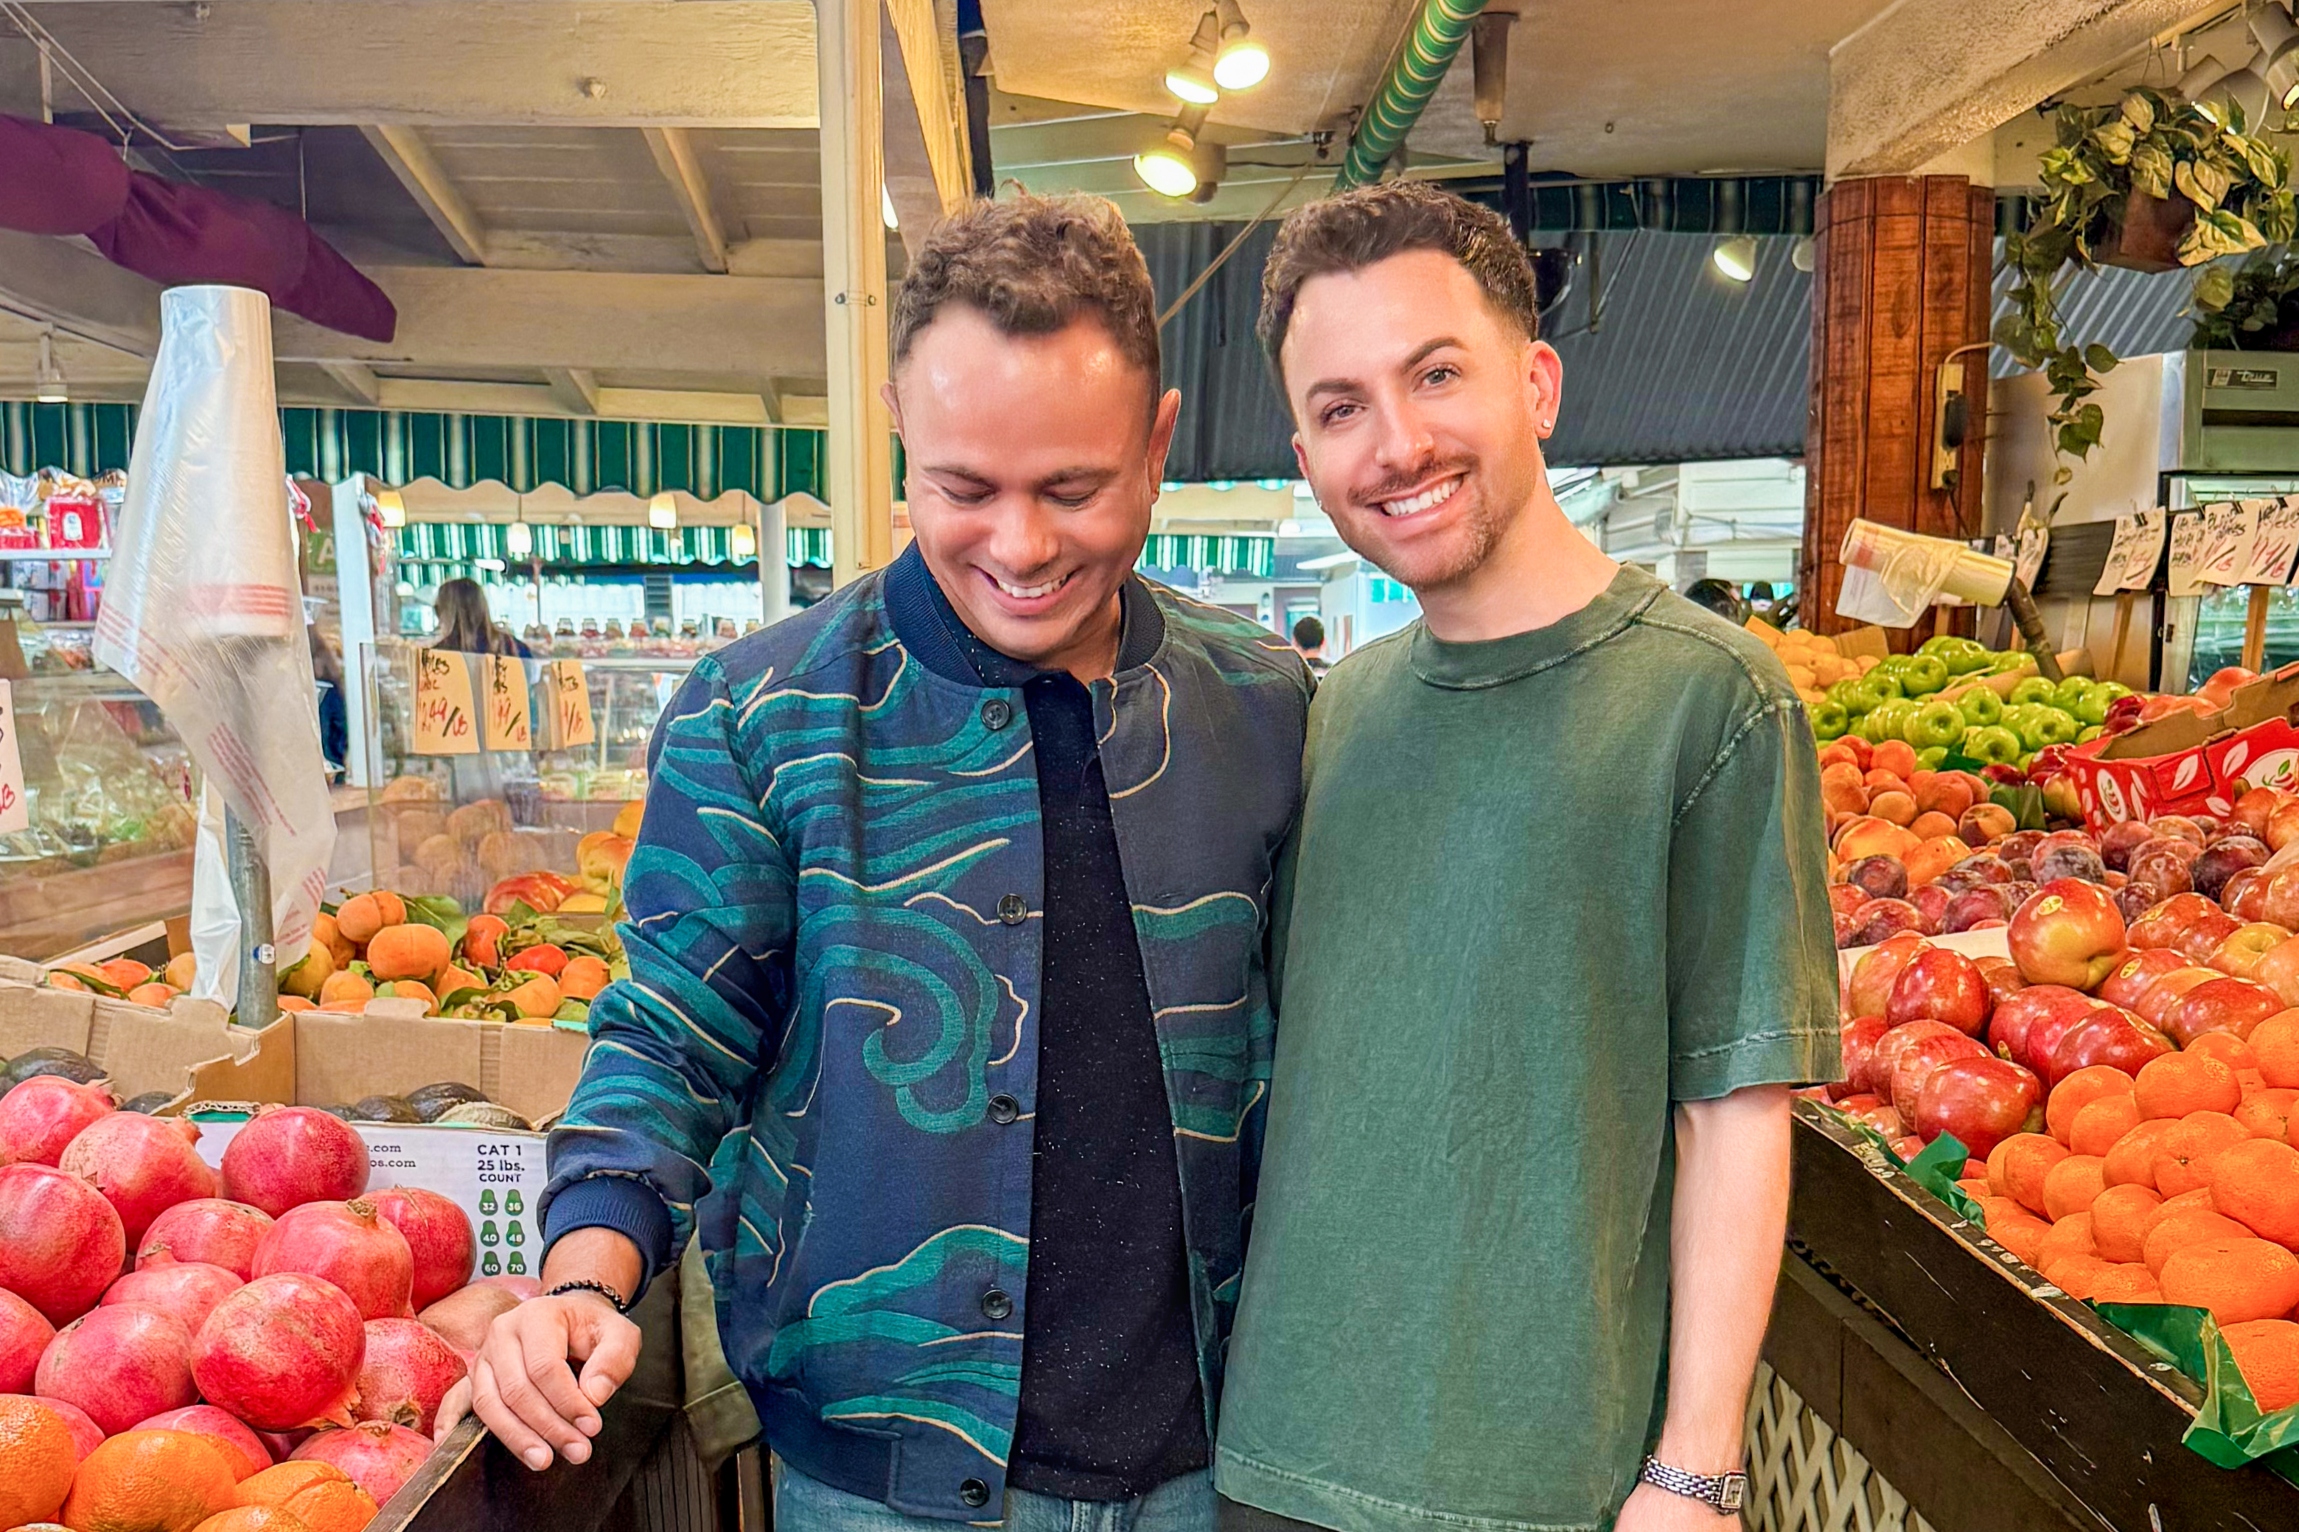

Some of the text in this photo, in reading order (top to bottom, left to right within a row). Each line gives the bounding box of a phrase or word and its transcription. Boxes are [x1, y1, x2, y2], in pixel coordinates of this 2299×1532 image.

[477, 1144, 522, 1156] CAT 1
[477, 1160, 526, 1172] 25 lbs.
[479, 1173, 522, 1183] COUNT
[482, 1202, 522, 1211] 32 36
[482, 1233, 523, 1242] 40 48
[484, 1263, 524, 1273] 60 70
